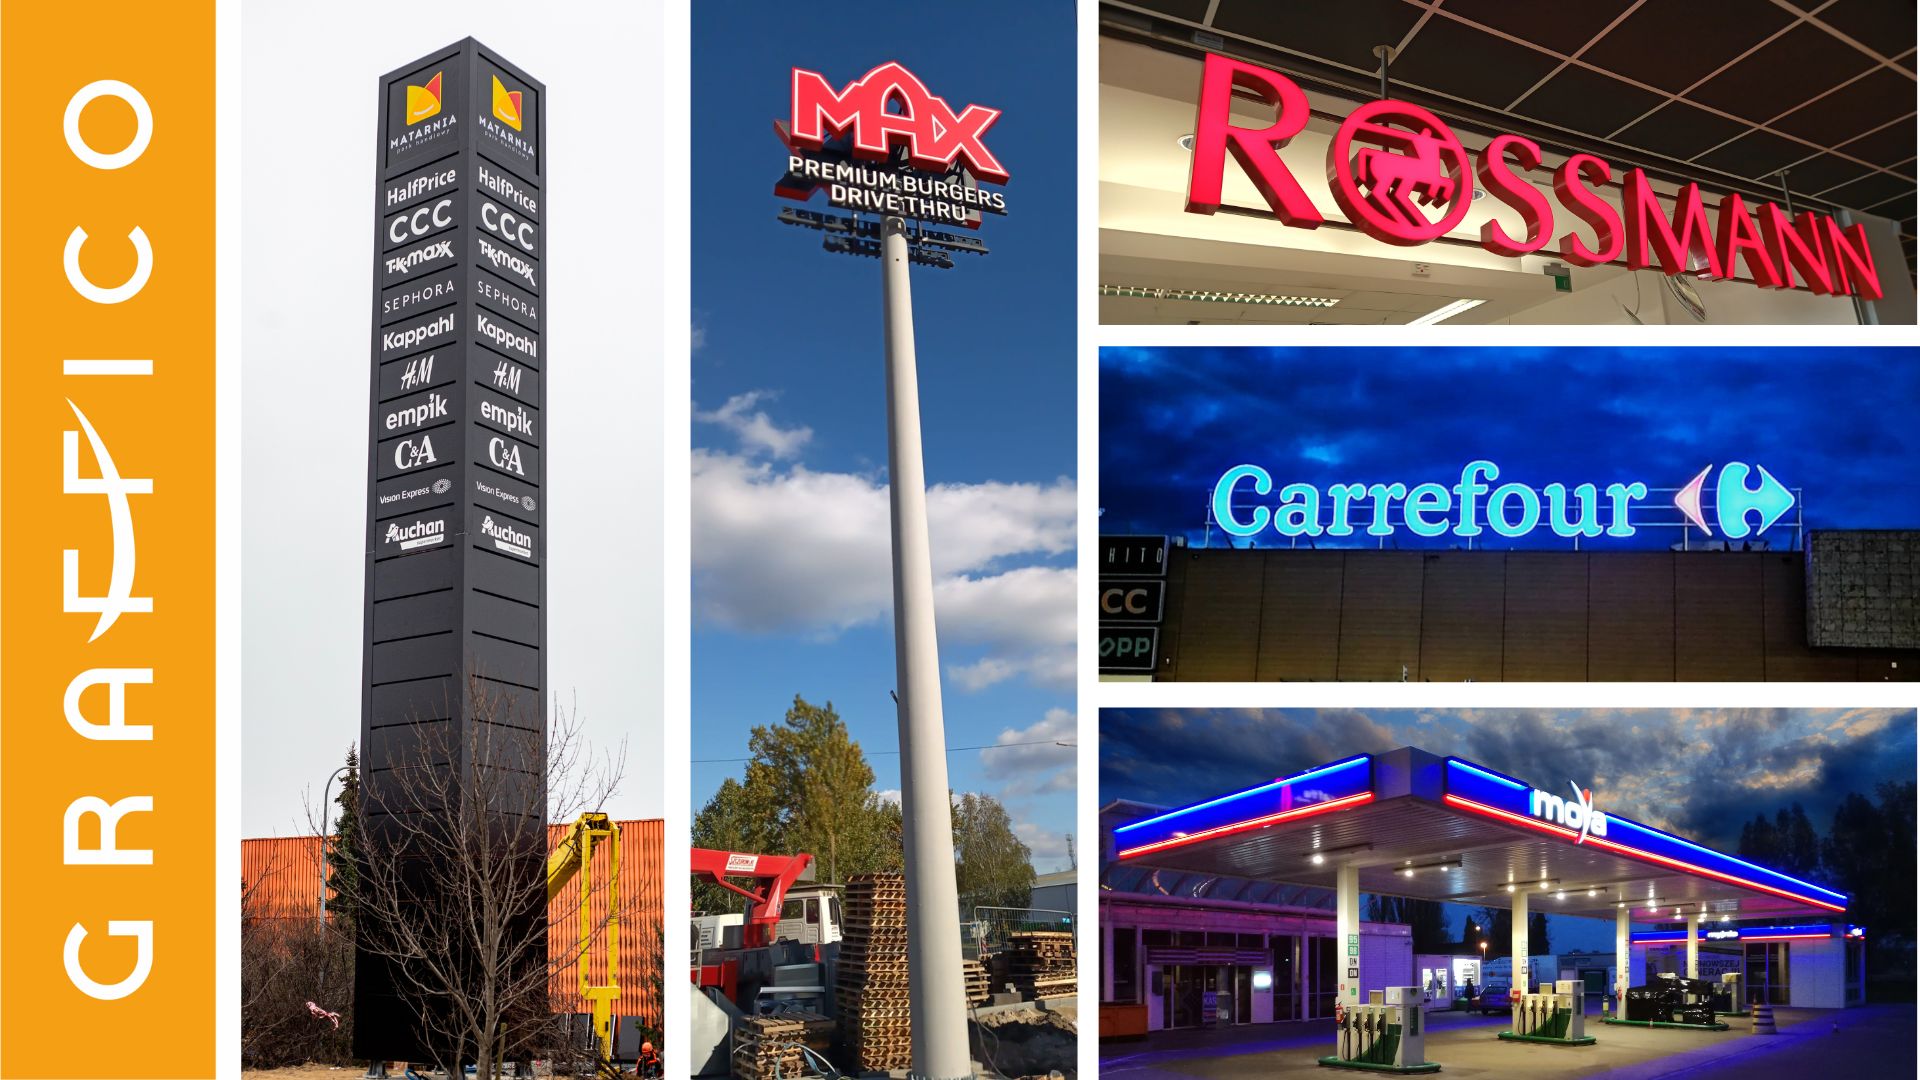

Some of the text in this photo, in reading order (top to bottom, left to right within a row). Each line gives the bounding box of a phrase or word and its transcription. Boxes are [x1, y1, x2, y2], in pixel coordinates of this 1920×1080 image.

[390, 114, 457, 149] MATARNIA
[478, 115, 535, 156] MATARNIA
[791, 60, 1010, 184] MAX
[387, 169, 456, 207] HalfPrice
[478, 166, 537, 213] HalfPrice
[788, 155, 1006, 209] PREMIUM BURGERS
[1185, 52, 1884, 300] ROSSMANN
[389, 200, 452, 243] CCC
[831, 184, 966, 221] DRIVE THRU
[481, 202, 534, 250] CCC
[384, 280, 454, 313] SEPHORA
[478, 280, 537, 320] SEPHORA
[383, 313, 454, 351] Kappahl
[477, 314, 537, 357] Kappahl
[401, 355, 434, 391] H&M
[493, 361, 521, 395] H&M
[386, 393, 448, 430] empik
[481, 401, 533, 436] empik
[394, 435, 437, 470] C&A
[489, 437, 525, 476] C&A
[401, 486, 430, 499] Express
[495, 488, 520, 505] Express
[1212, 460, 1648, 537] Carrefour
[385, 519, 445, 544] Auchan
[481, 515, 531, 549] Auchan
[1533, 780, 1607, 844] moya
